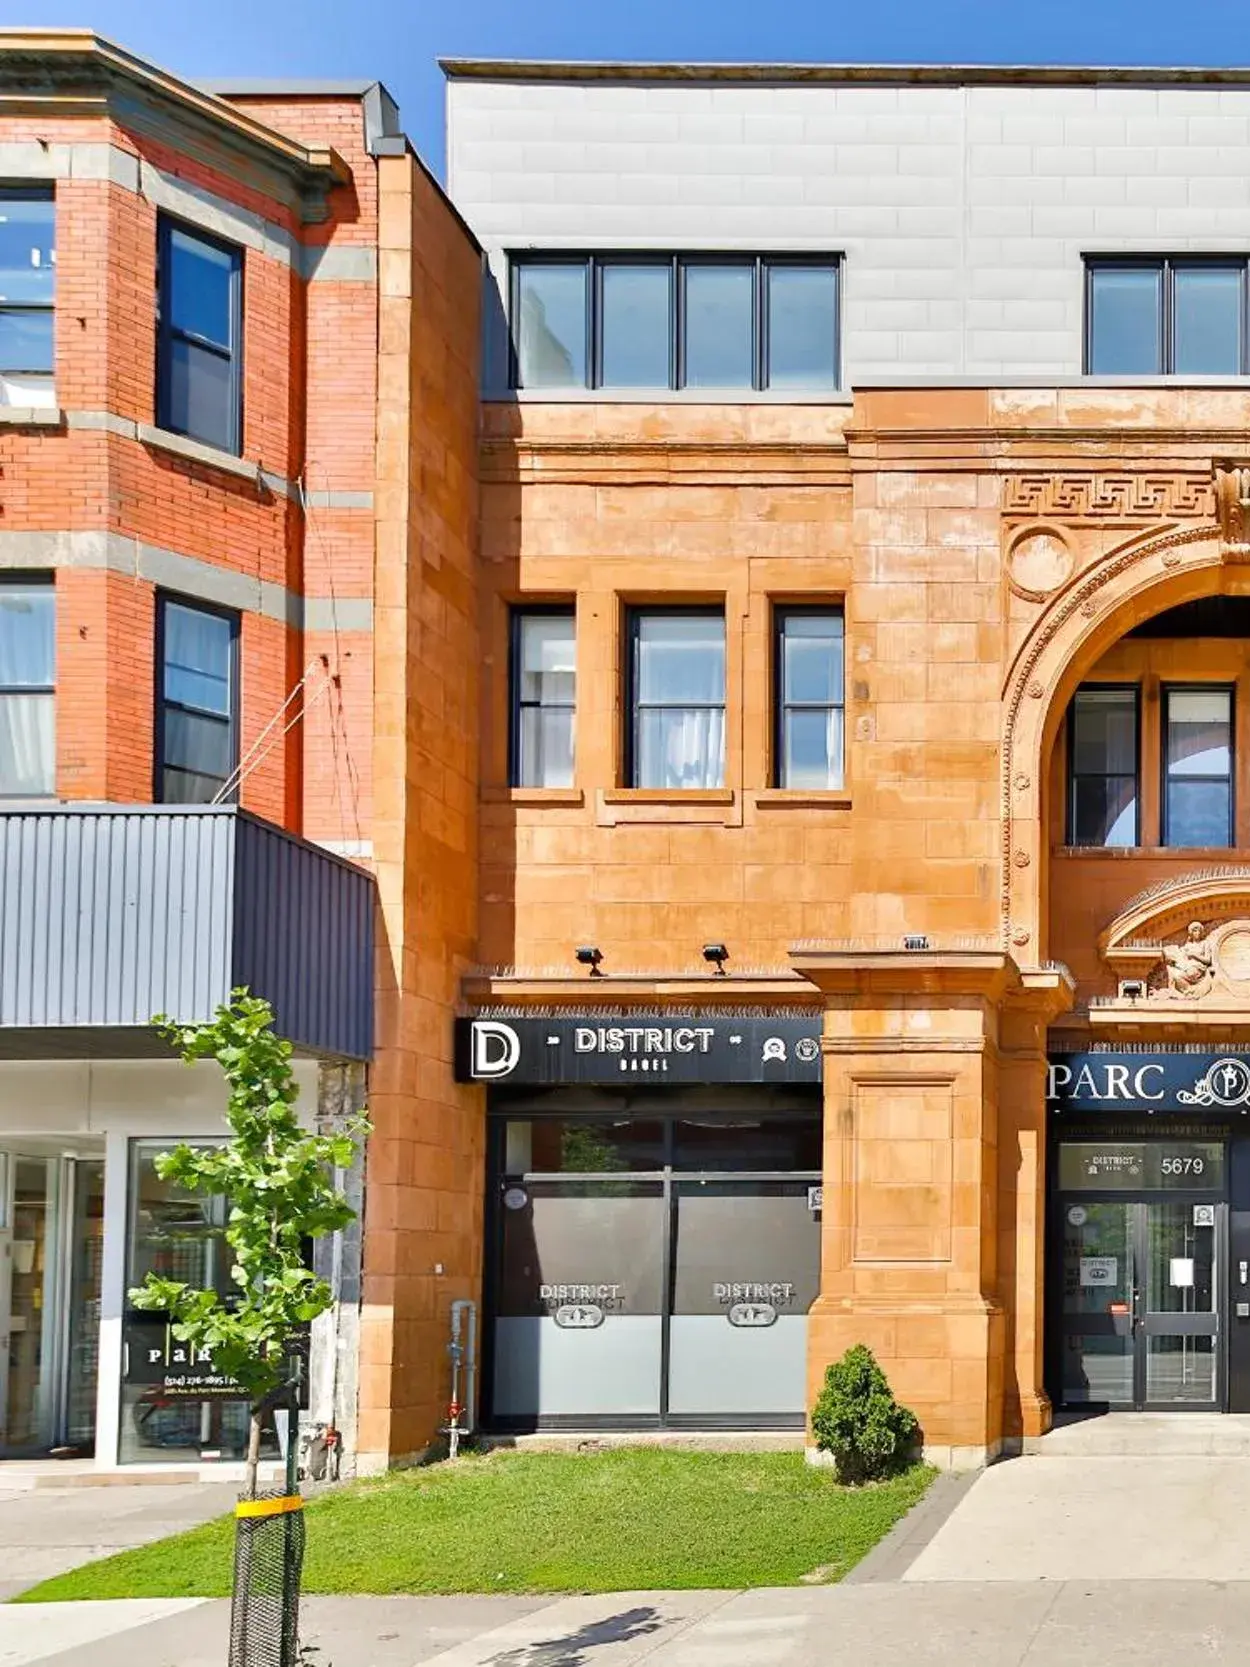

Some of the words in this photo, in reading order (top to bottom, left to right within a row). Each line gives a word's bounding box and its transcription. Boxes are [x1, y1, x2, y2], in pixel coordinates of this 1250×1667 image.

[575, 1027, 714, 1053] DISTRICT
[471, 1021, 521, 1079] D
[618, 1059, 669, 1071] BAGEL
[1046, 1064, 1165, 1100] PARC
[1161, 1157, 1204, 1175] 5679
[540, 1284, 620, 1298] DISTRICT
[713, 1282, 793, 1298] DISTRICT
